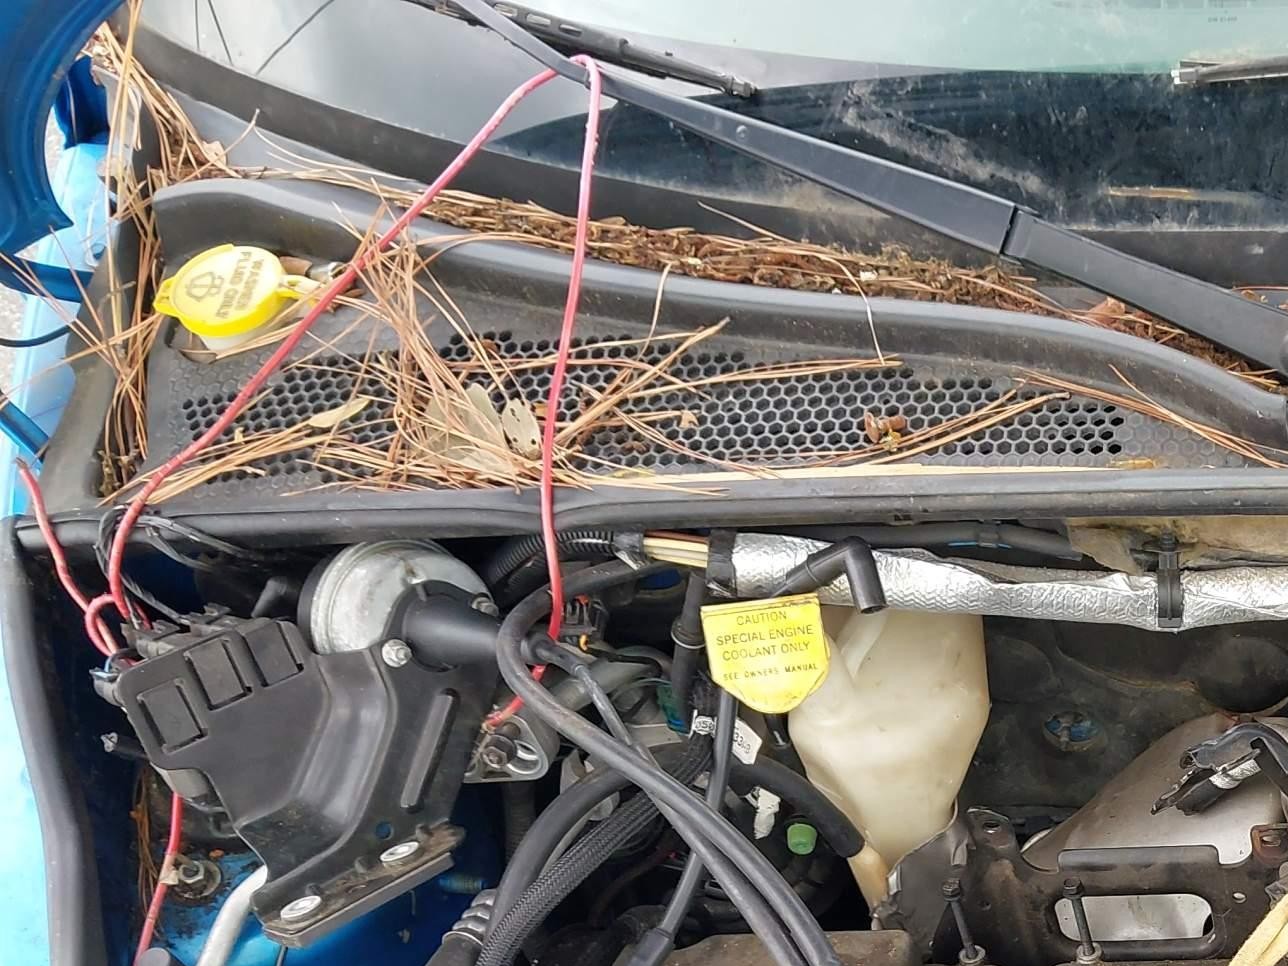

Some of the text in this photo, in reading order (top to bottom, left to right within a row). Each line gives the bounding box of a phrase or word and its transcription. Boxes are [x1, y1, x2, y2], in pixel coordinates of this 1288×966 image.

[737, 611, 787, 625] CAUTION
[716, 625, 813, 646] SPECIAL ENGINE
[722, 641, 810, 661] COOLANT ONLY
[785, 664, 818, 673] MANUAL
